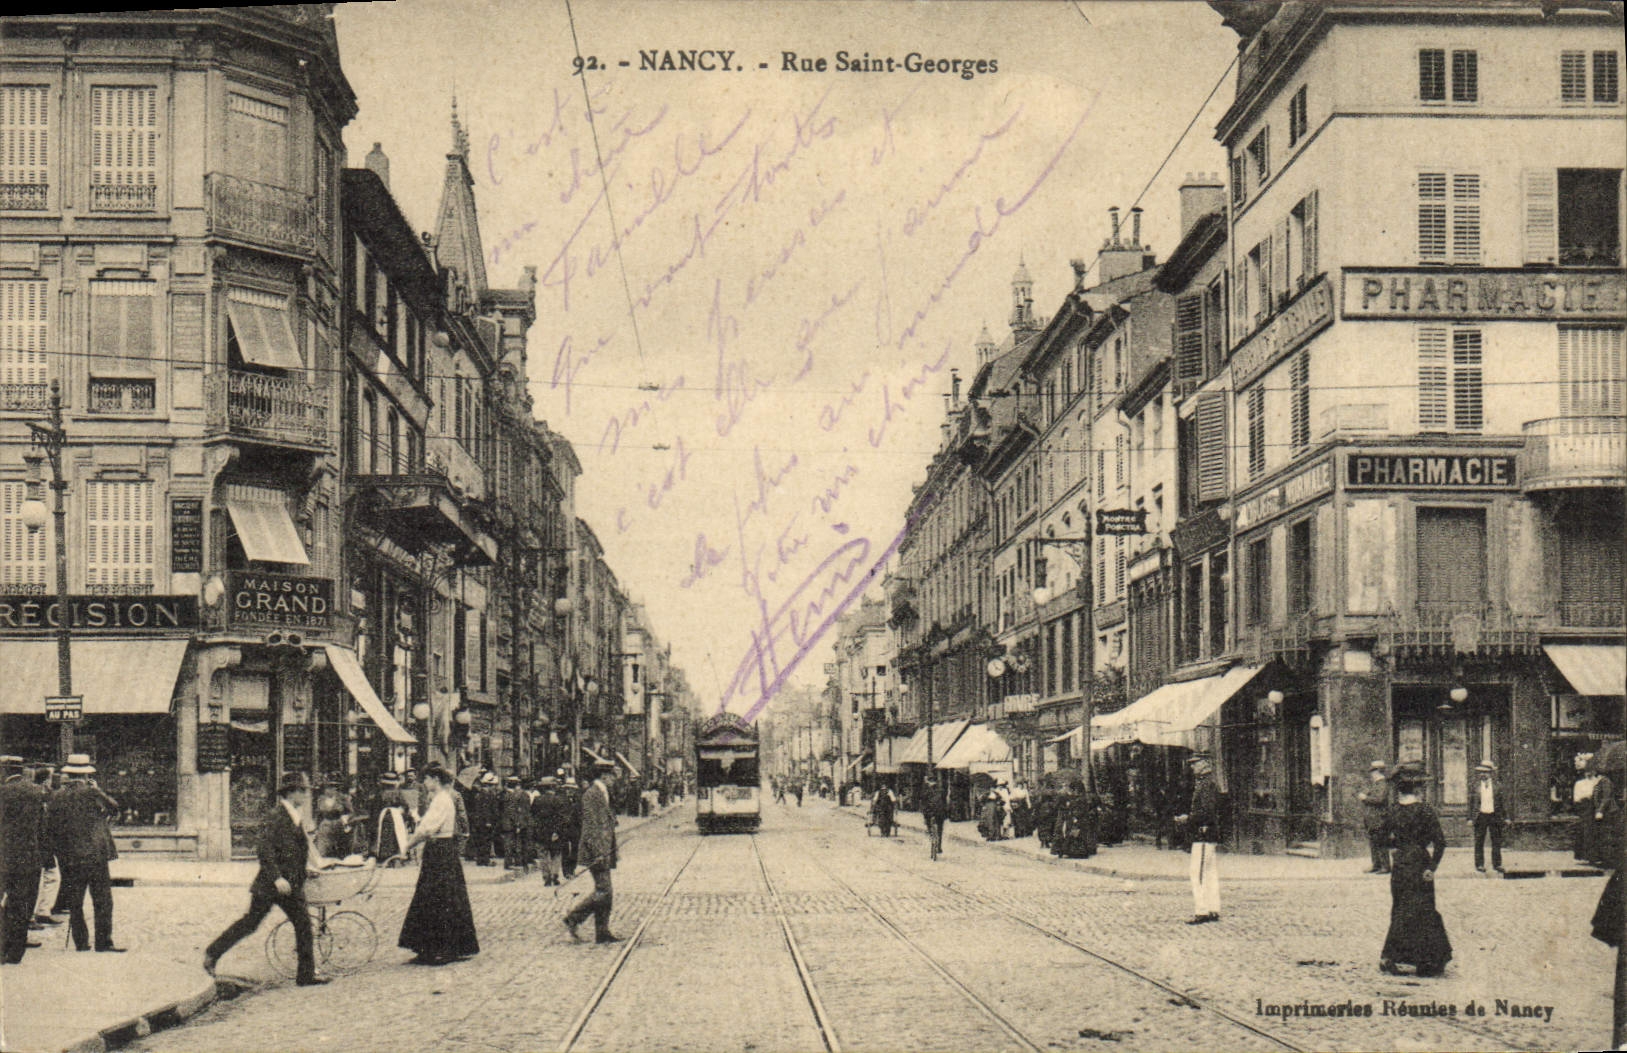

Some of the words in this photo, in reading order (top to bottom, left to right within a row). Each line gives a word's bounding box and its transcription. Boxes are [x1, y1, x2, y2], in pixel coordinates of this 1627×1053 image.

[542, 106, 753, 312] Famille
[1362, 276, 1602, 312] PHARMACIE
[1357, 457, 1508, 485] PHARMACIE
[243, 578, 319, 595] MAISON
[235, 591, 327, 615] GRAND
[234, 608, 281, 624] FONDÉE
[286, 613, 301, 625] EN
[63, 711, 80, 720] PAS
